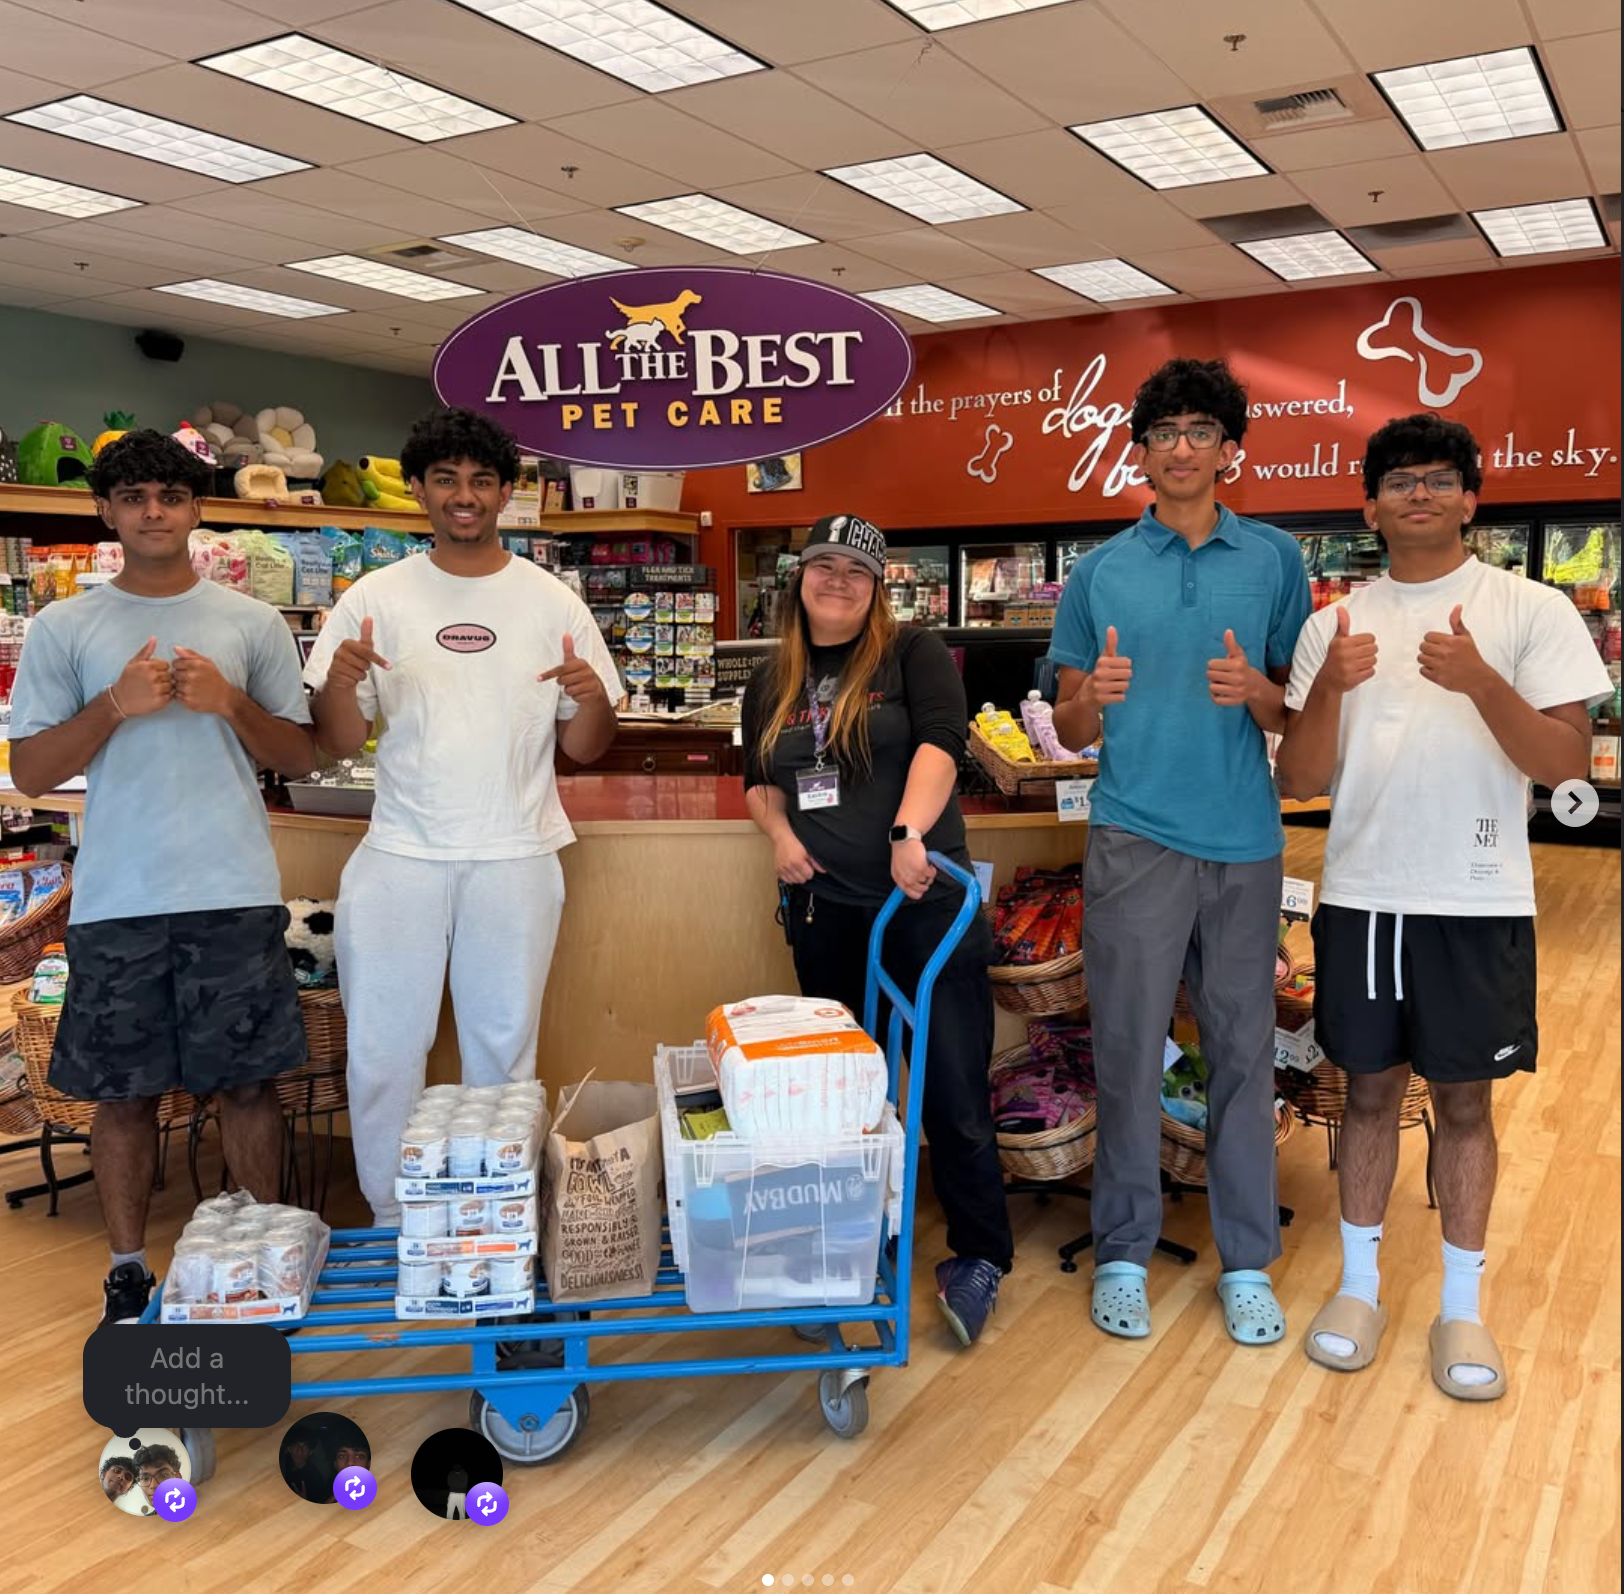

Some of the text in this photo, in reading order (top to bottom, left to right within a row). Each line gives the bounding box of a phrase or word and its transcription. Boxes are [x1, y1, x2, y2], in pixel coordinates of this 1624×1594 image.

[486, 329, 862, 402] ALL THE BEST
[910, 383, 945, 415] the
[1037, 368, 1063, 402] of
[1245, 378, 1354, 419] swered,
[562, 397, 783, 430] PET CARE
[948, 387, 1032, 421] prayers
[1042, 353, 1138, 492] dog
[1253, 443, 1340, 480] would
[1493, 427, 1618, 477] the sky.
[561, 1217, 628, 1235] RESPONSIBLY
[563, 1237, 597, 1248] GROWN
